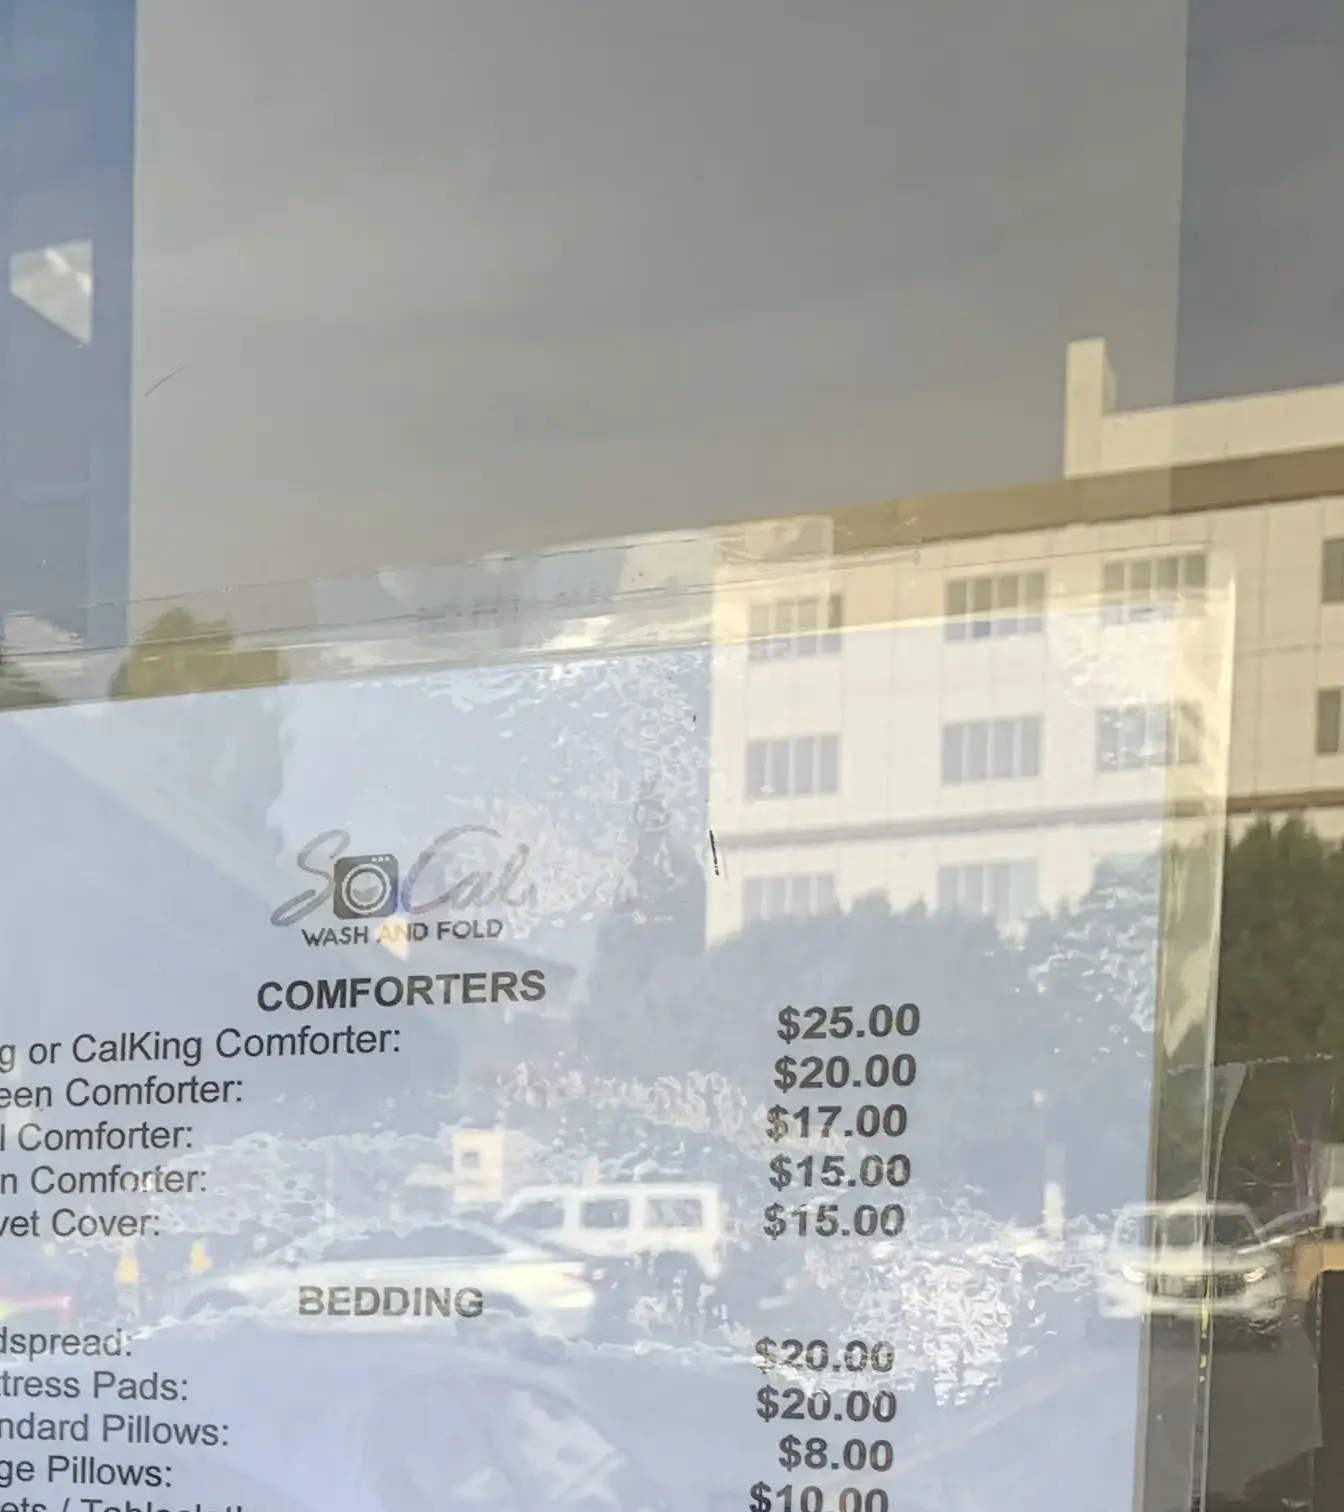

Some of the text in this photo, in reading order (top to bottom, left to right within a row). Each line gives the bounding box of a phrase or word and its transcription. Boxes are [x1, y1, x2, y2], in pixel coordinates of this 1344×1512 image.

[301, 919, 504, 947] WASH AND FOLD
[257, 969, 547, 1013] COMFORTERS
[776, 1002, 921, 1045] $25.00
[28, 1041, 63, 1066] or
[71, 1030, 203, 1068] CalKing
[215, 1024, 401, 1059] Comforter:
[65, 1074, 243, 1108] Comforter:
[773, 1053, 917, 1094] $20.00
[17, 1120, 193, 1152] Comforter:
[765, 1103, 908, 1144] $17.00
[30, 1163, 207, 1195] Comforter:
[768, 1153, 912, 1193] $15.00
[51, 1207, 160, 1238] Cover:
[762, 1201, 906, 1241] $15.00
[298, 1285, 485, 1319] BEDDING
[754, 1335, 895, 1374] $20.00
[93, 1370, 188, 1402] Pads:
[756, 1384, 898, 1424] $20.00
[102, 1413, 229, 1447] Pillows:
[47, 1454, 172, 1488] Pillows:
[778, 1433, 894, 1473] $8.00
